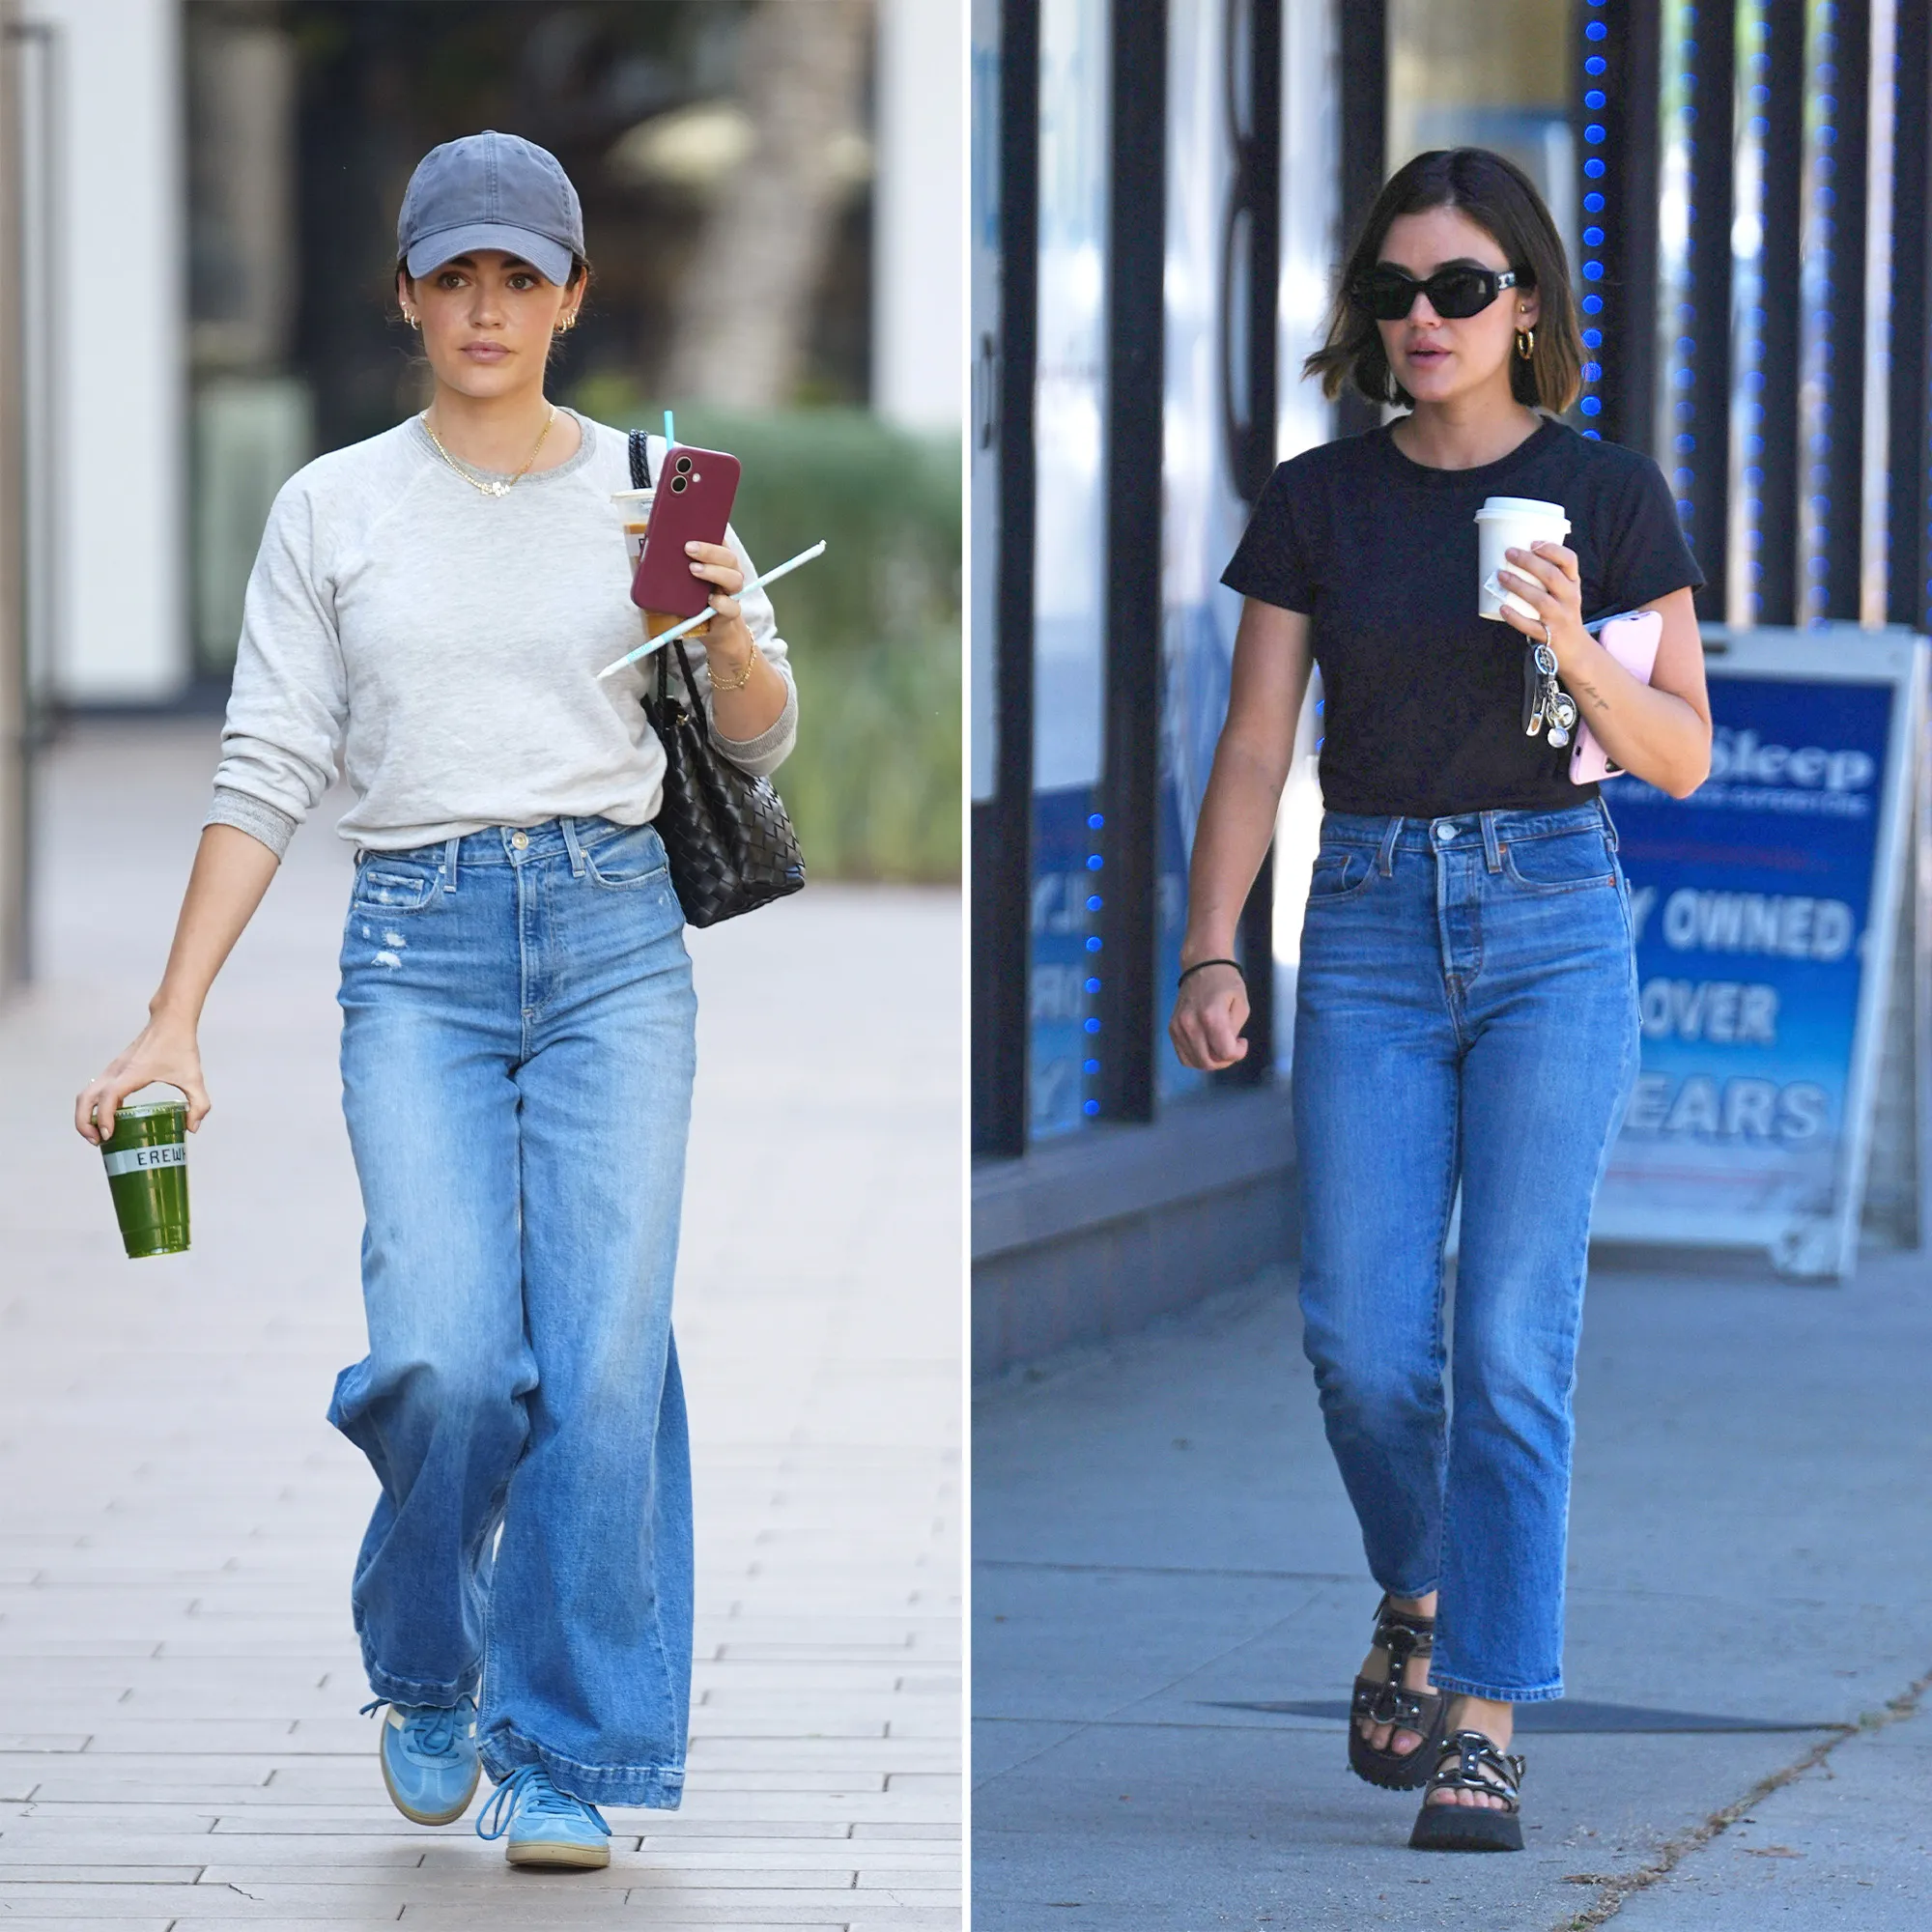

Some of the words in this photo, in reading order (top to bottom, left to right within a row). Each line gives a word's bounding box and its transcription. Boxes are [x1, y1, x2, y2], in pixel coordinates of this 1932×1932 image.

[1664, 889, 1852, 959] OWNED
[1643, 979, 1777, 1042] OVER
[1627, 1074, 1826, 1138] EARS
